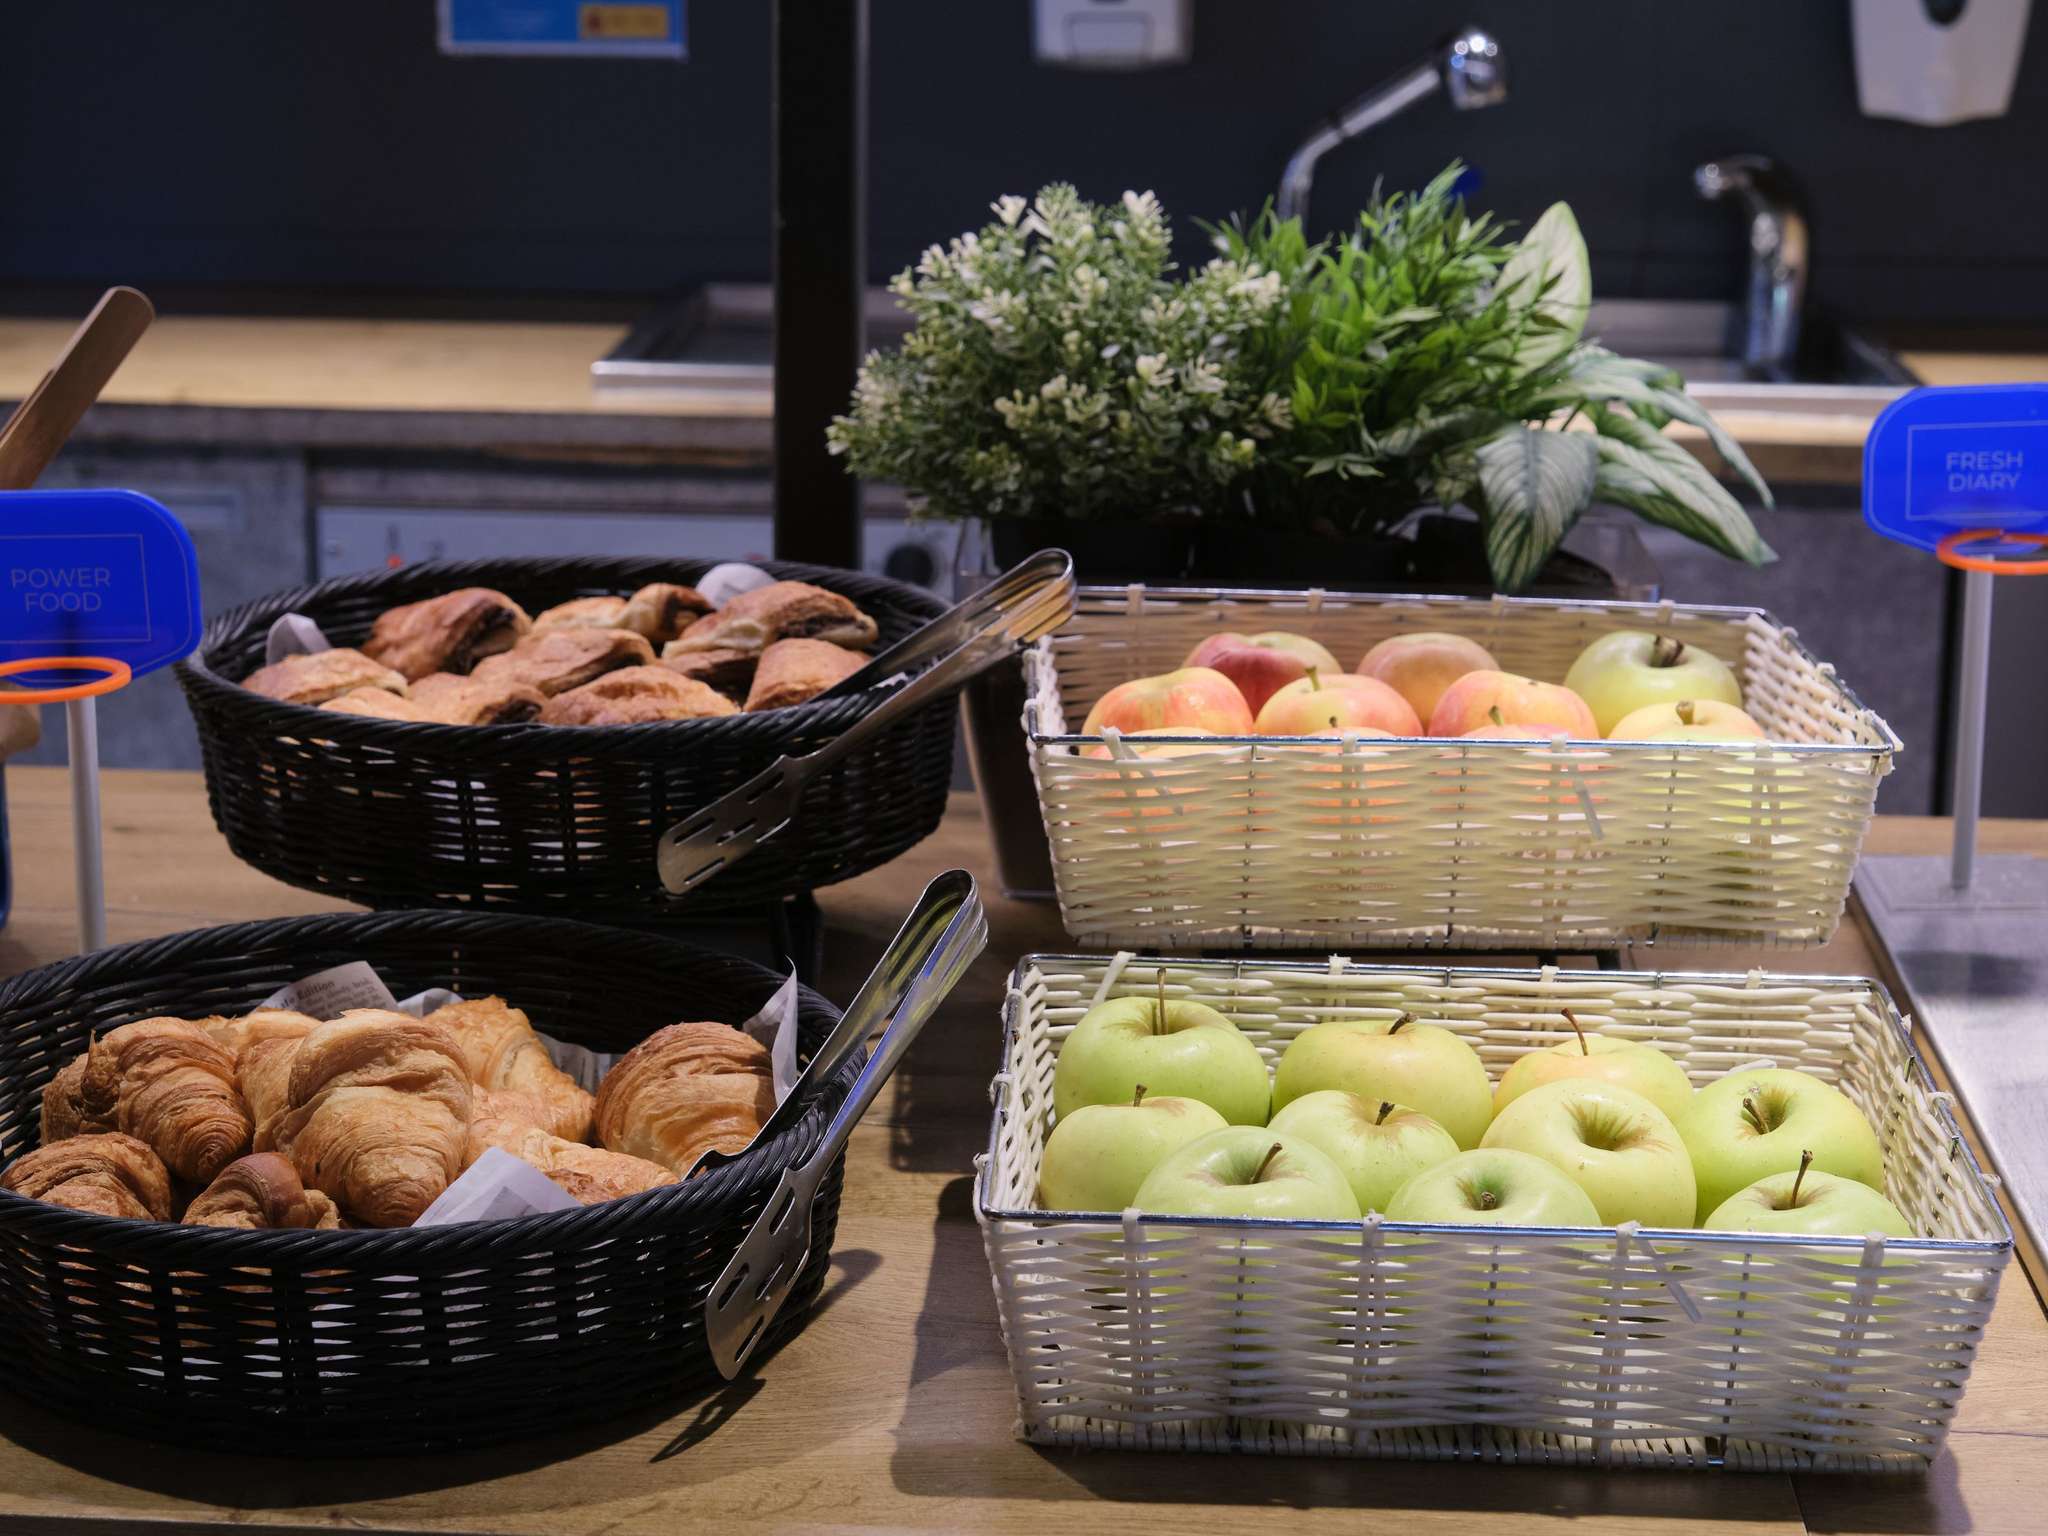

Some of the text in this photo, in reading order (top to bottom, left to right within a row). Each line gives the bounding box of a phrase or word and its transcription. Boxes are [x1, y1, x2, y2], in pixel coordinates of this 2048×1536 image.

[1946, 451, 2024, 471] FRESH
[1948, 471, 2021, 492] DIARY
[10, 567, 112, 588] POWER
[24, 591, 102, 612] FOOD
